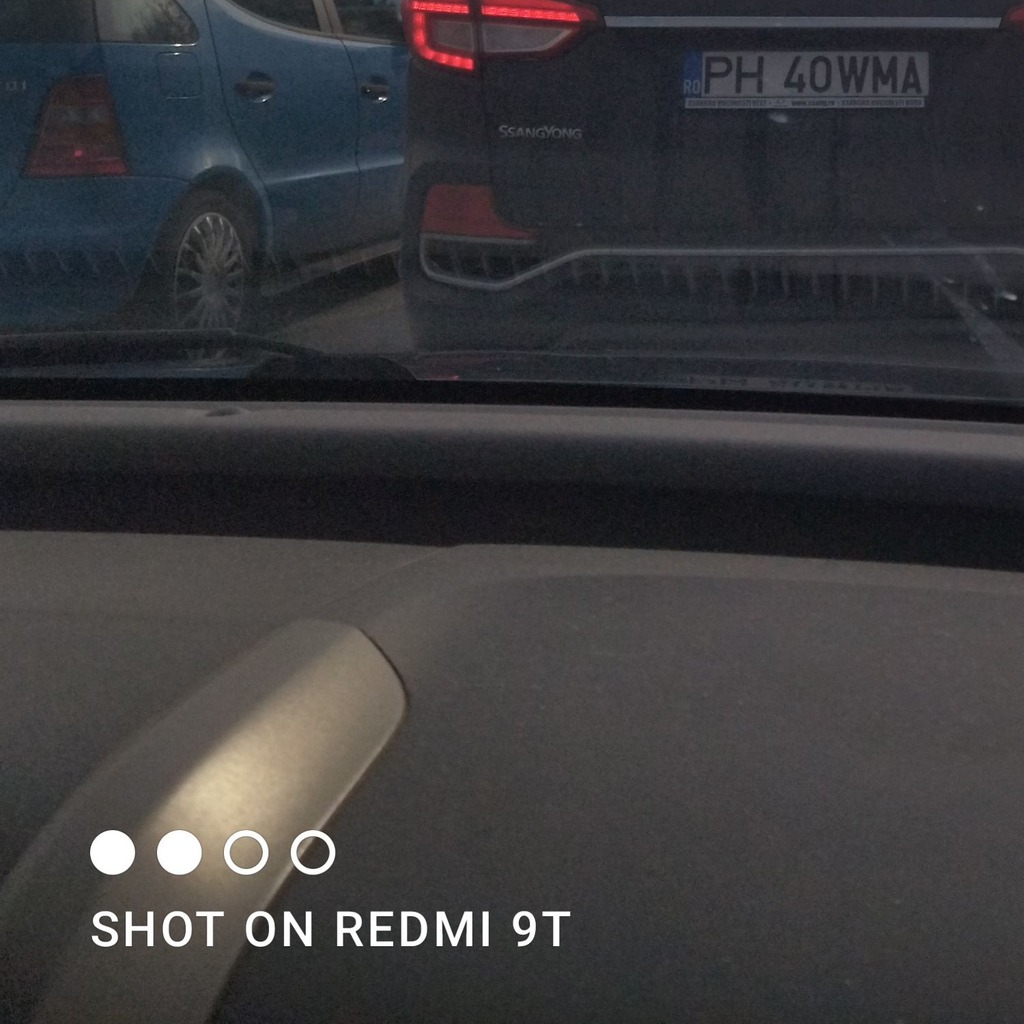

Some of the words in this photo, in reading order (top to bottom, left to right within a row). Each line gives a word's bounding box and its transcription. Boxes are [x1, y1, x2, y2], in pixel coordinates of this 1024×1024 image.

[683, 79, 700, 95] RO
[704, 56, 765, 94] PH
[783, 55, 922, 94] 40WMA
